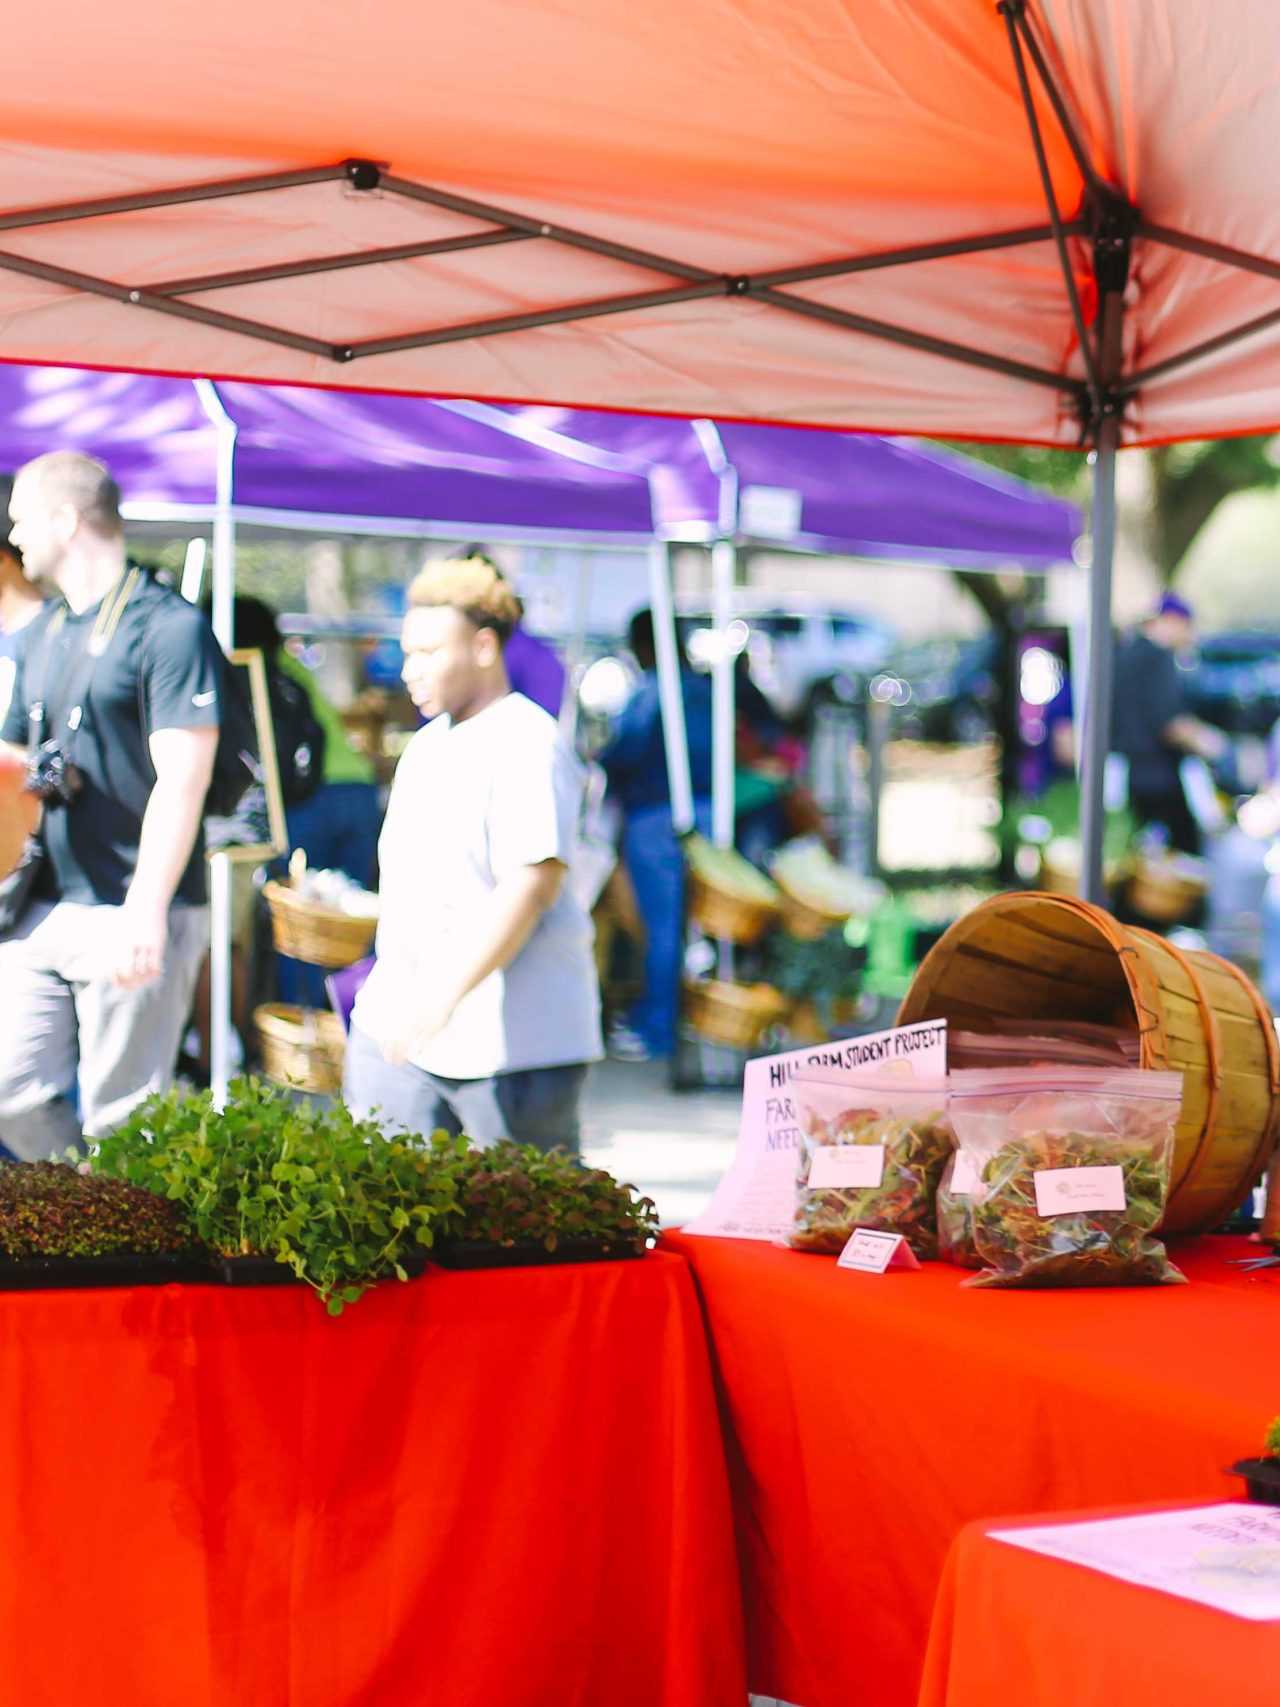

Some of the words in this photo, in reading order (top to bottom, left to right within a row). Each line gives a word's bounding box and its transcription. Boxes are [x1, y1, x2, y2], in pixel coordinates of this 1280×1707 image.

[808, 1051, 844, 1070] ARM
[846, 1037, 892, 1069] STUDENT
[895, 1025, 947, 1056] PROJECT
[765, 1096, 797, 1125] FAR
